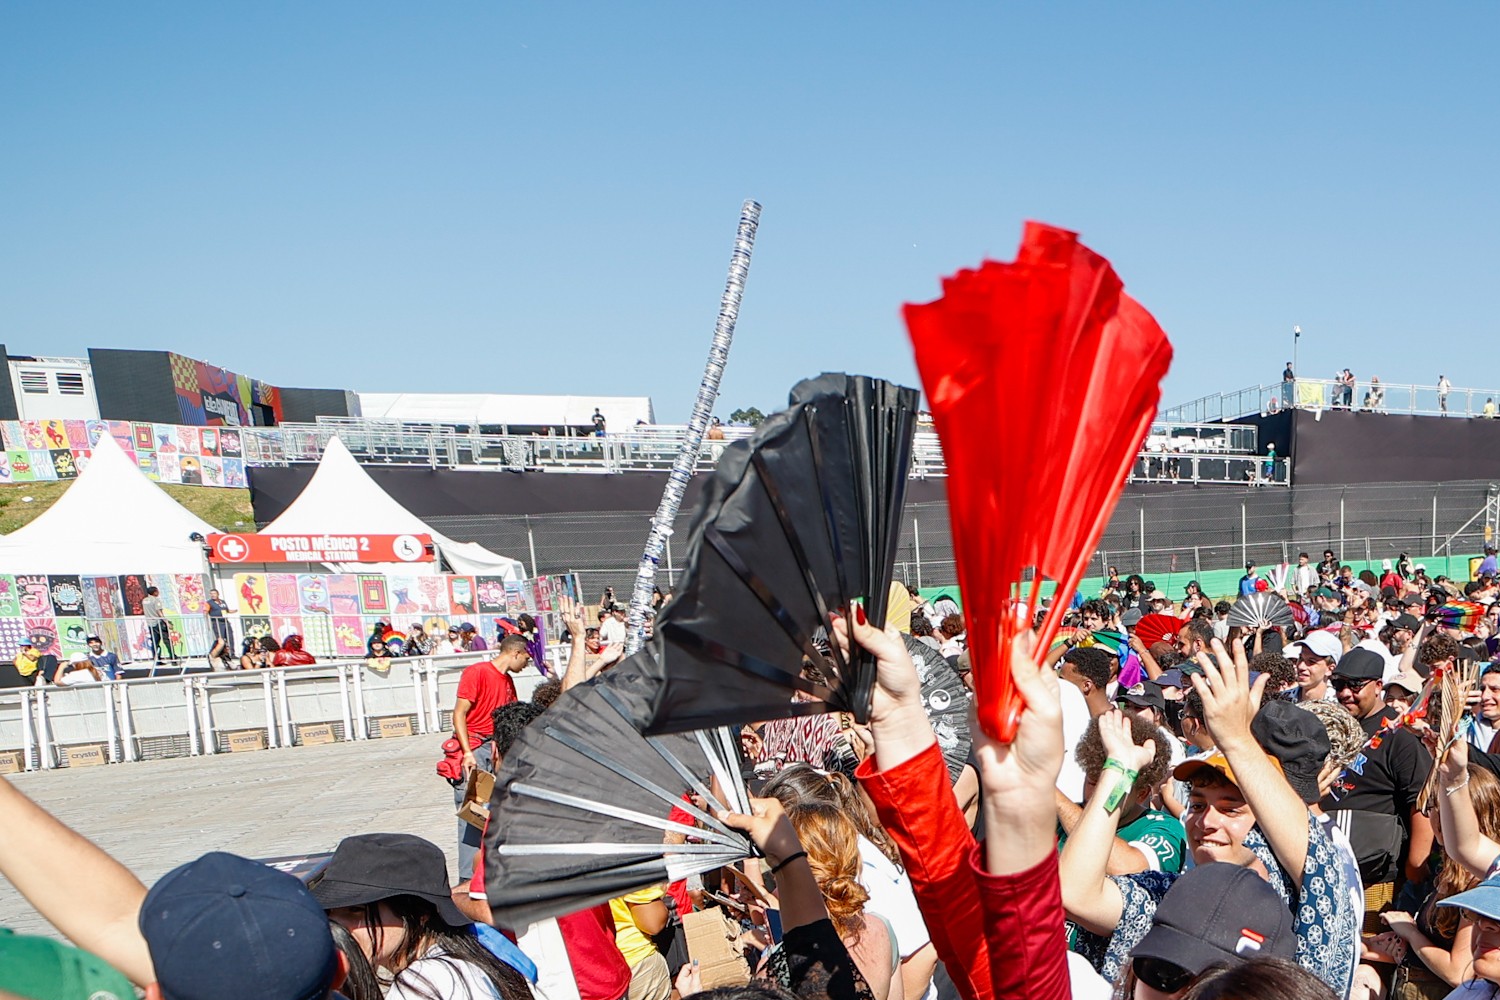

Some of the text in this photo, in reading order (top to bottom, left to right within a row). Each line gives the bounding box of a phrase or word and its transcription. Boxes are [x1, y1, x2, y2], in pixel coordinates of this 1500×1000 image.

[270, 534, 370, 551] POSTO MÉDICO 2
[285, 551, 359, 561] MEDICAL STATION
[382, 721, 407, 731] crystal
[303, 729, 329, 739] crystal
[233, 735, 259, 745] crystal
[71, 751, 99, 761] crystal
